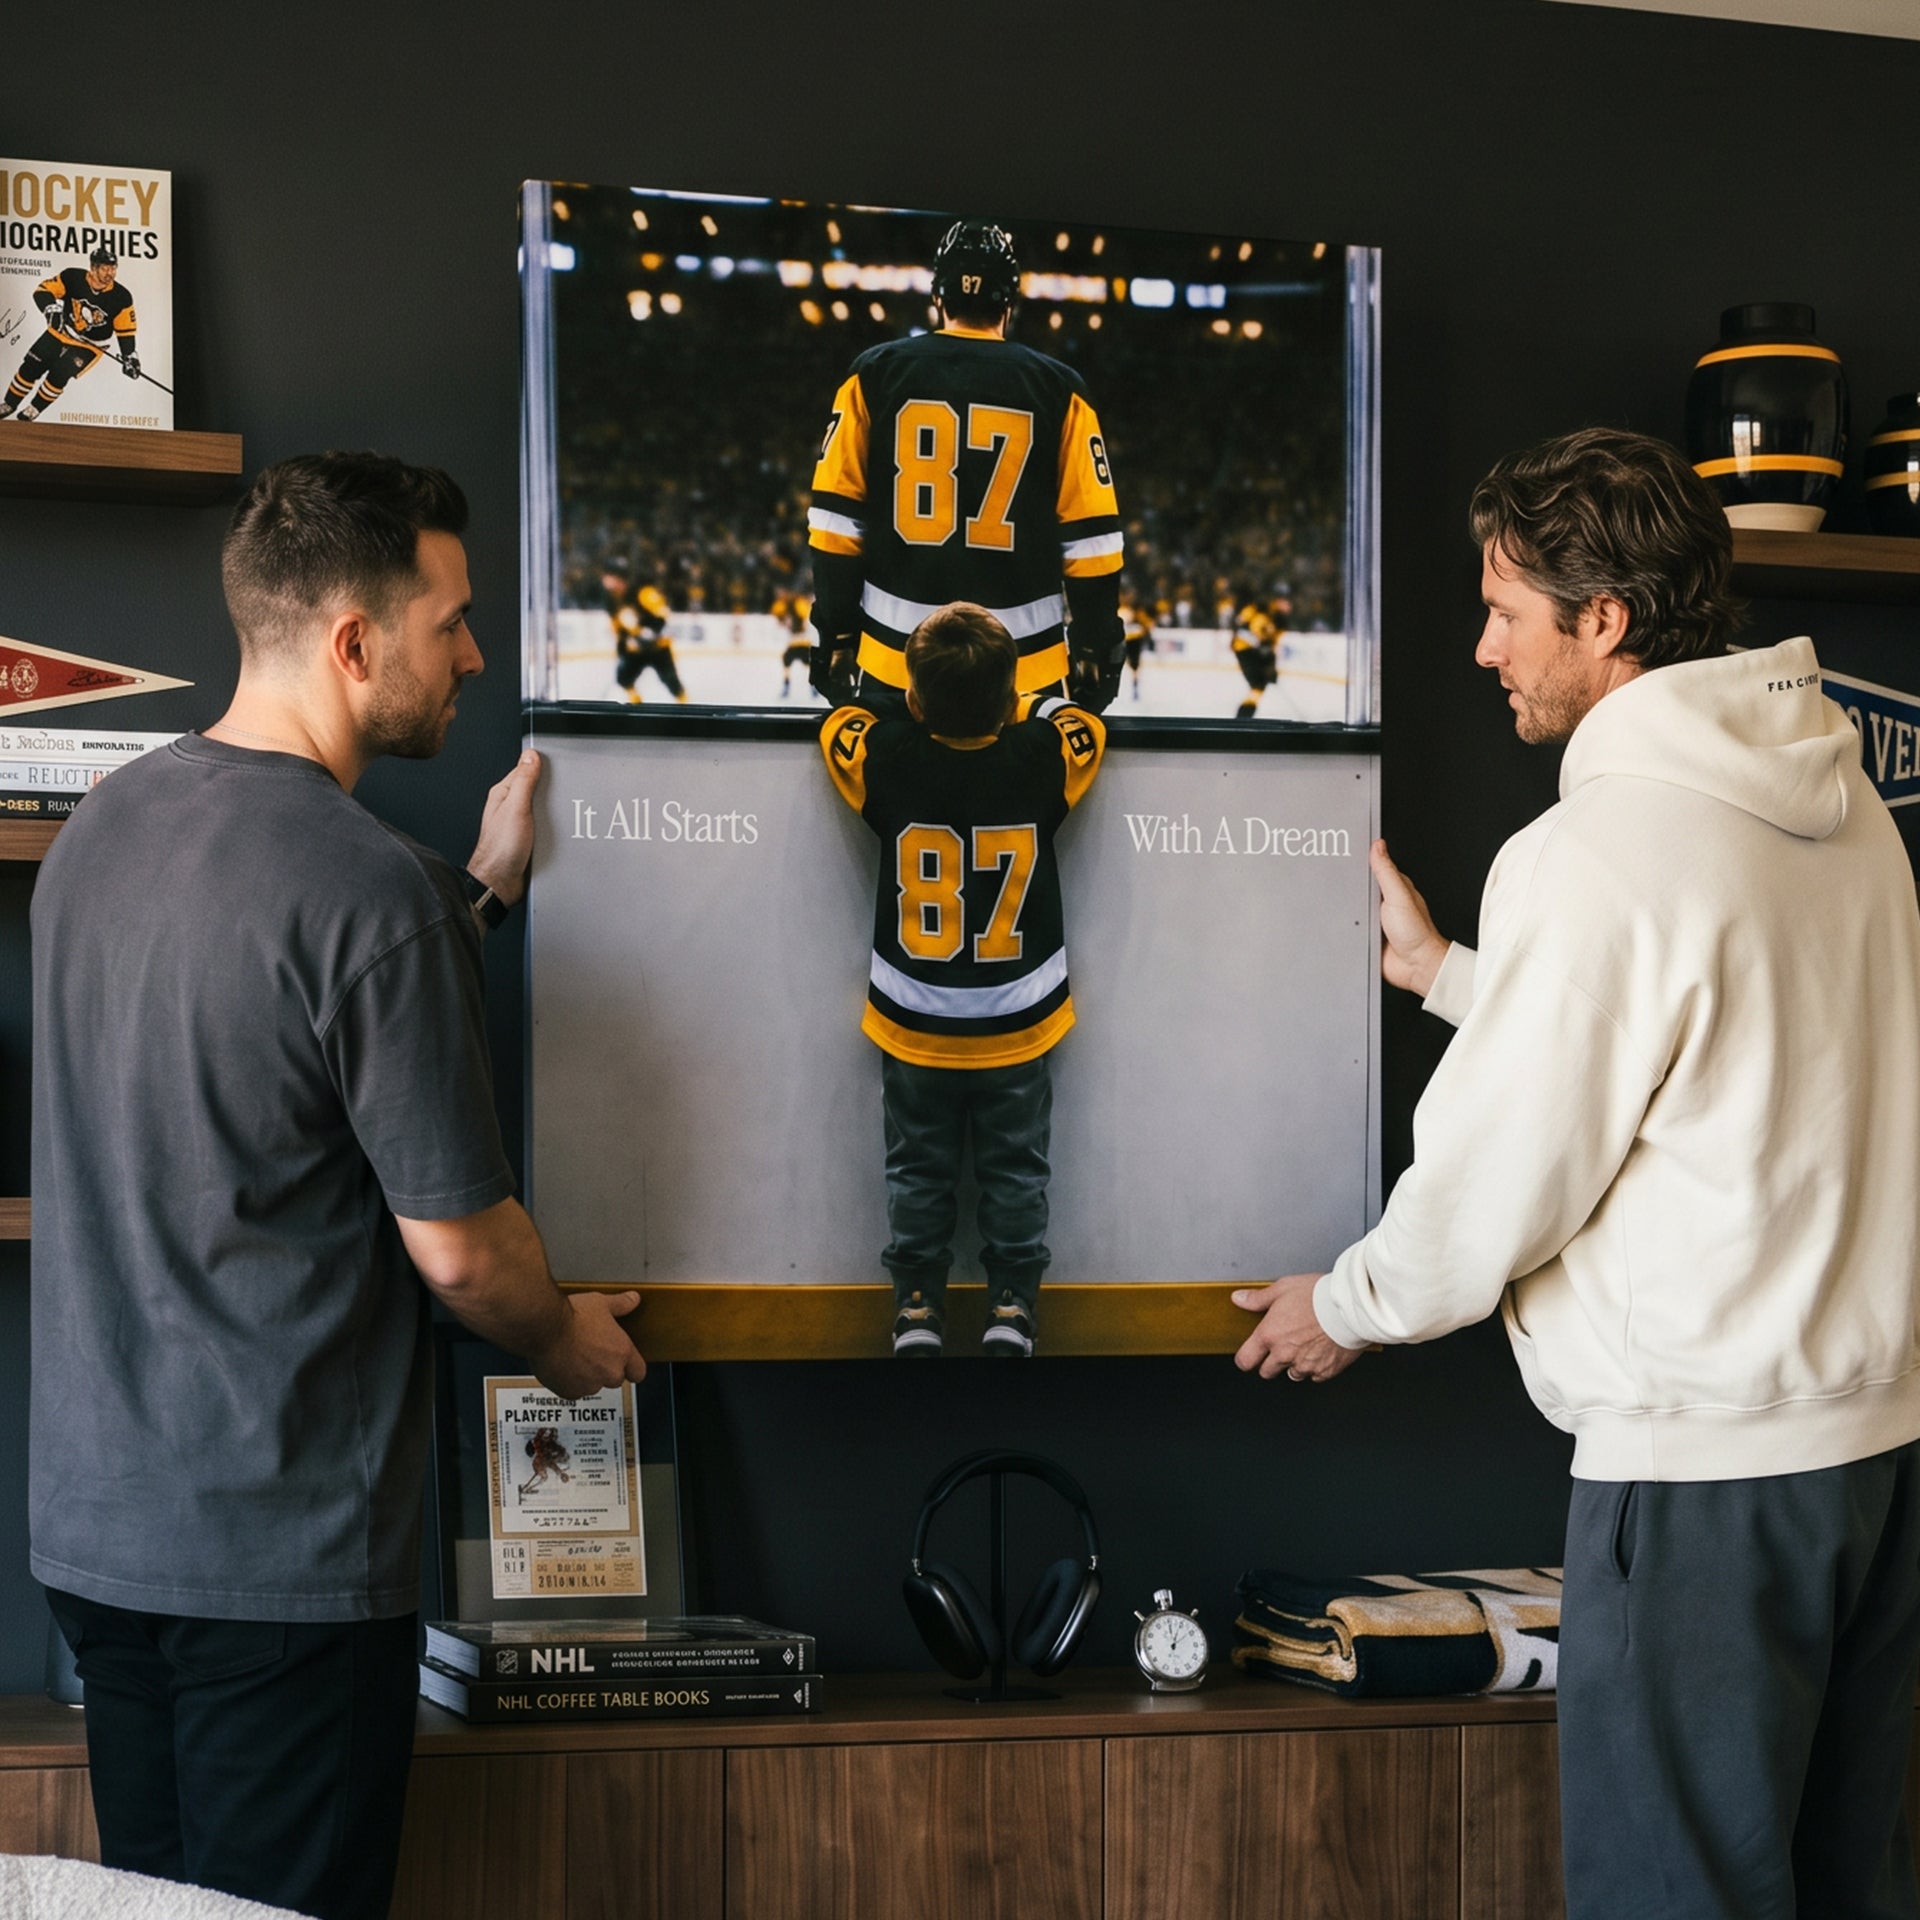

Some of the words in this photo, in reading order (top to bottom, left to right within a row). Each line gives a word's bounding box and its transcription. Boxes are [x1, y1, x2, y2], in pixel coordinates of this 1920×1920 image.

[961, 275, 982, 294] 87
[894, 399, 1034, 551] 87
[571, 799, 598, 840] It
[604, 798, 652, 841] All
[661, 800, 759, 844] Starts
[1123, 813, 1204, 854] With
[1210, 816, 1238, 855] A
[1243, 816, 1352, 857] Dream
[896, 822, 1038, 963] 87
[569, 1408, 617, 1421] TICKET
[531, 1647, 595, 1674] NHL
[497, 1695, 533, 1710] NHL
[537, 1692, 597, 1709] COFFEE
[601, 1691, 649, 1707] TABLE
[654, 1690, 710, 1706] BOOKS
